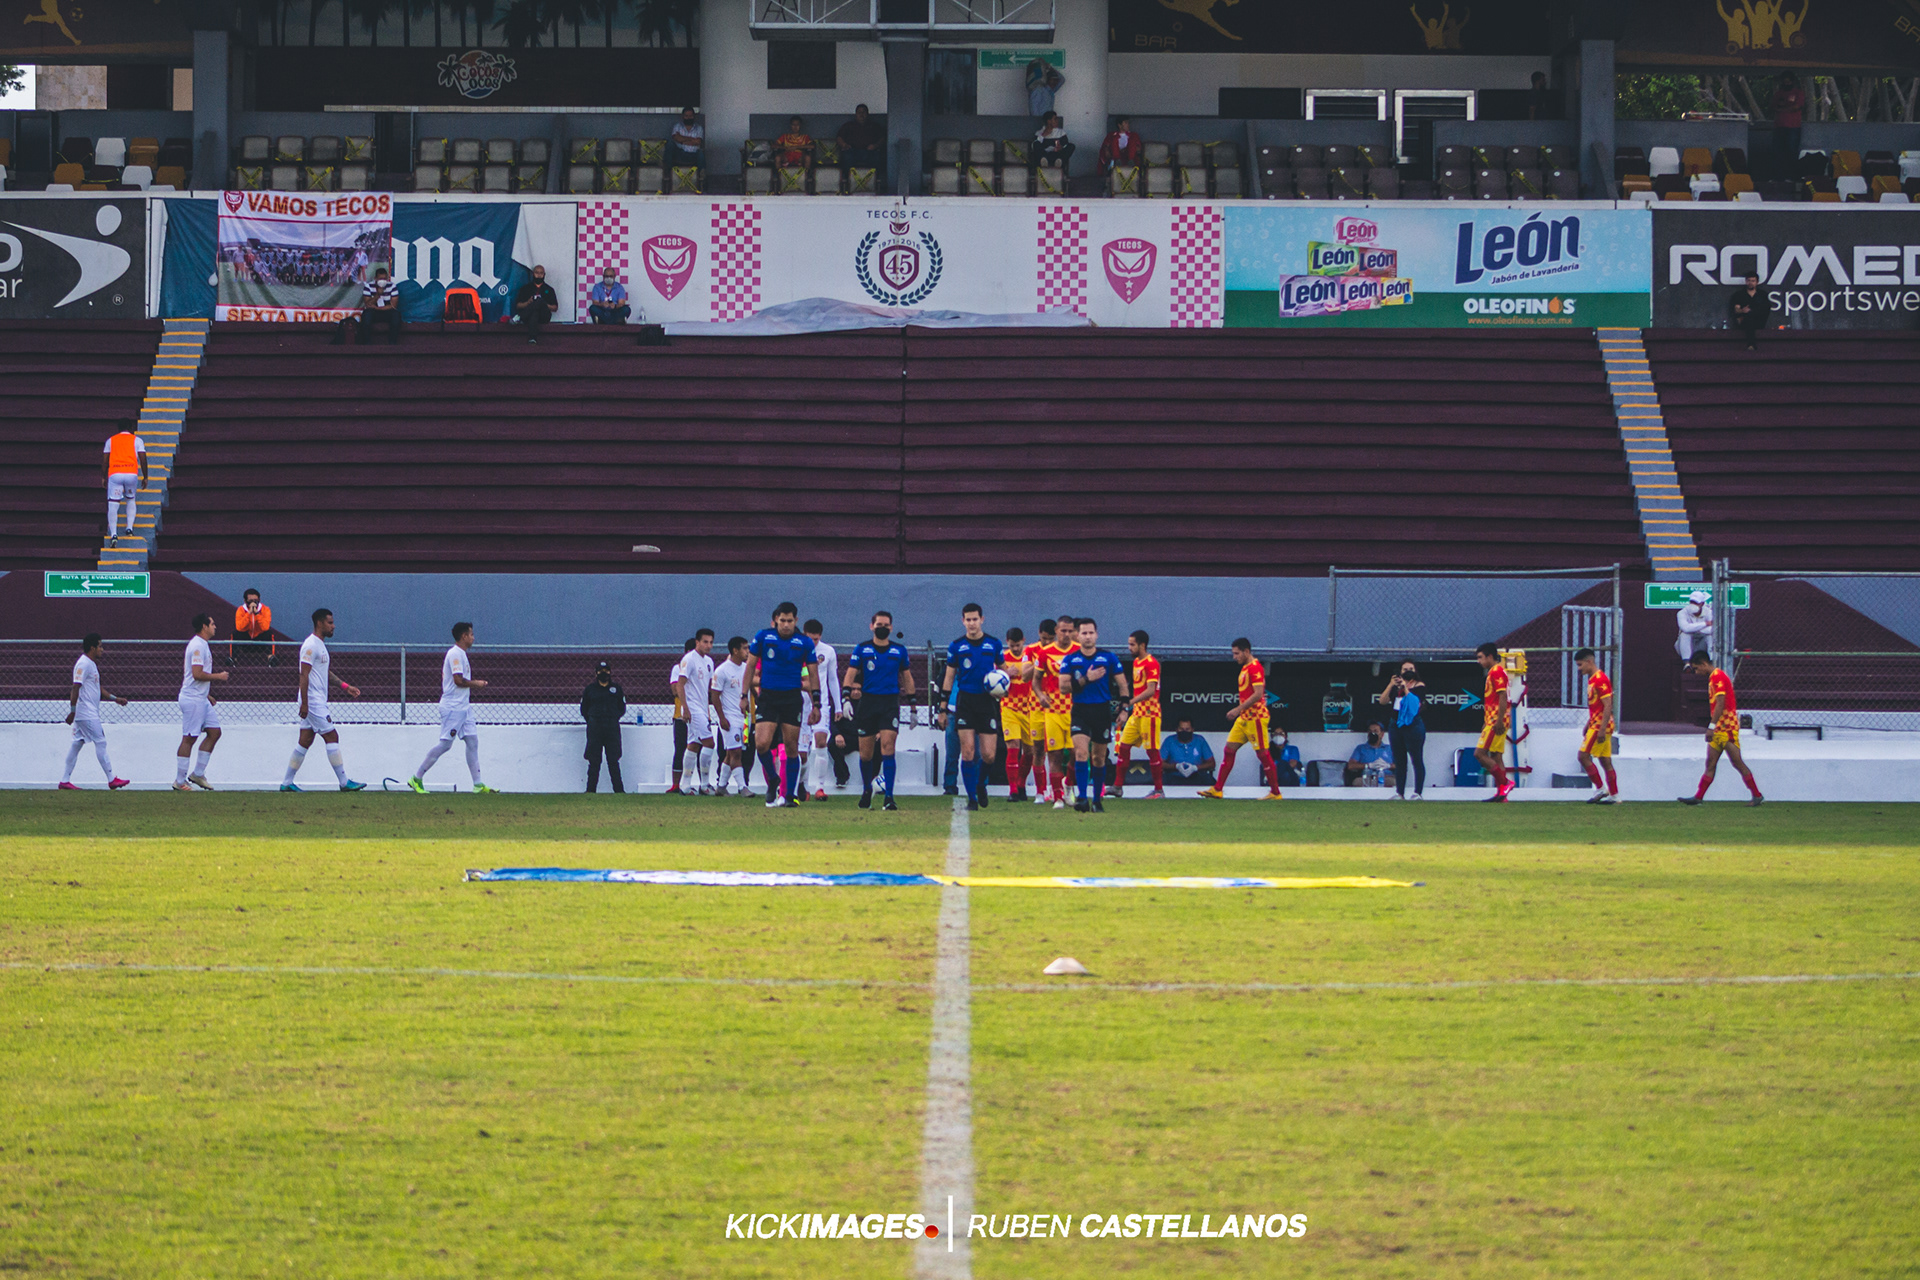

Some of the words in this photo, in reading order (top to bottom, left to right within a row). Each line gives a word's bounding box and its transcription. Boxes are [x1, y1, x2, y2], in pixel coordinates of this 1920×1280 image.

[1134, 34, 1177, 49] BAR
[247, 192, 318, 217] VAMOS
[323, 194, 391, 216] TECOS
[866, 210, 907, 219] TECOS
[911, 210, 933, 219] F.C.
[1338, 222, 1377, 240] León
[657, 237, 683, 246] TECOS
[1117, 241, 1142, 249] TECOS
[1455, 211, 1580, 284] León
[885, 254, 913, 275] 45
[1312, 248, 1355, 270] León
[1359, 252, 1394, 272] León
[1491, 273, 1518, 285] Jabón
[1519, 270, 1530, 280] de
[1532, 263, 1580, 278] Lavandería
[1283, 280, 1336, 310] León
[1341, 281, 1378, 305] León
[1381, 281, 1410, 300] León
[227, 308, 289, 322] SEXTA
[293, 310, 363, 322] DIVIS
[1468, 316, 1573, 325] www.oleofinos.com.mx
[1171, 693, 1240, 703] POWER
